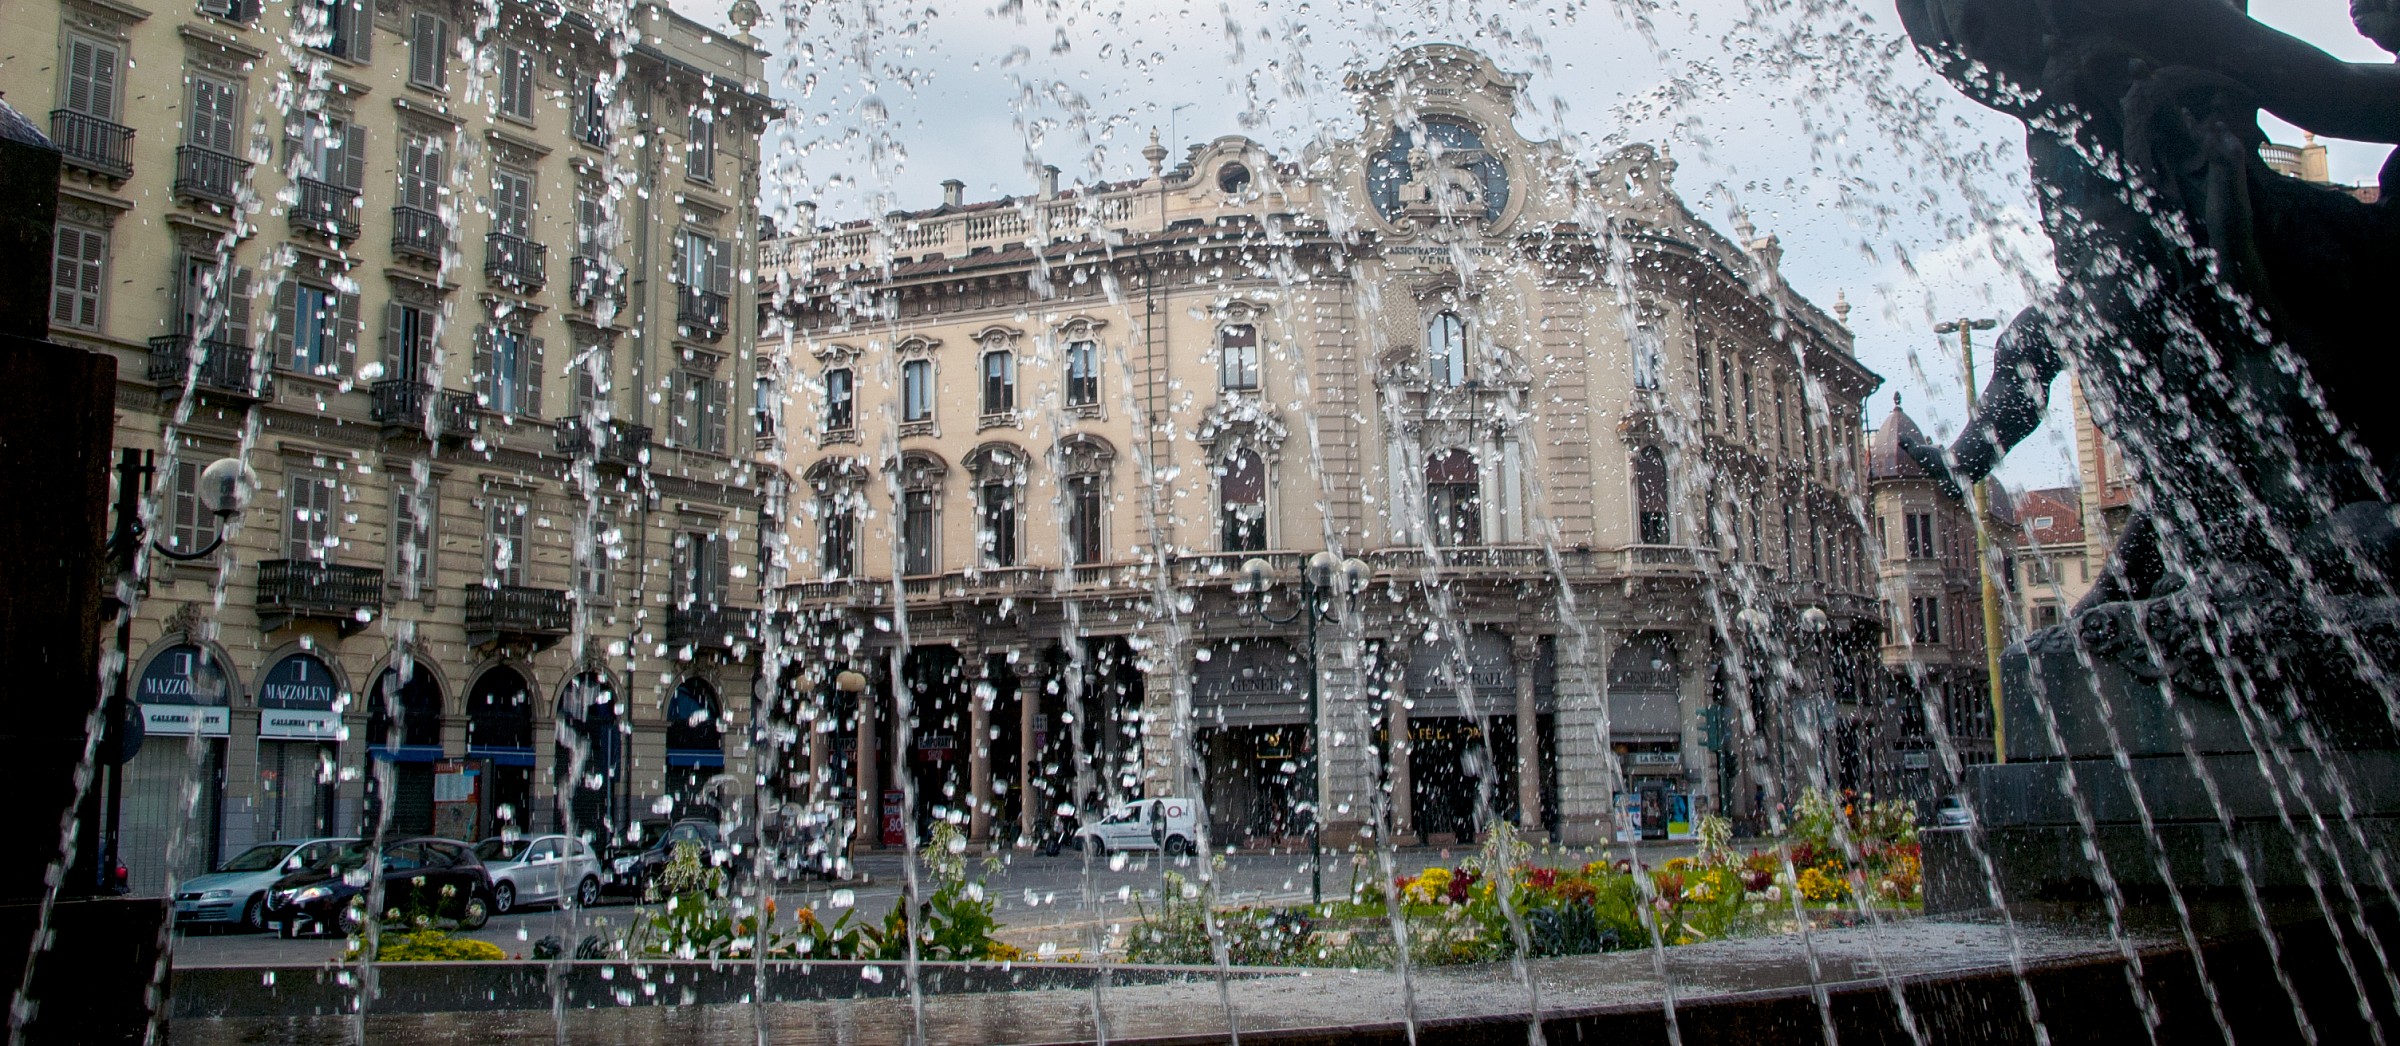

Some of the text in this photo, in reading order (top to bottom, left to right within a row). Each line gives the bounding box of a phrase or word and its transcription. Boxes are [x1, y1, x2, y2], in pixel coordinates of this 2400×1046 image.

[1390, 246, 1452, 255] ASSICVRATION
[1231, 678, 1300, 692] GENERI
[1433, 673, 1501, 686] GRALI
[146, 678, 213, 695] MAZZOL
[265, 684, 331, 701] MAZZOLENI
[151, 714, 189, 723] GALLERIA
[271, 719, 305, 727] GALLERIA
[919, 737, 951, 747] TMPORARY
